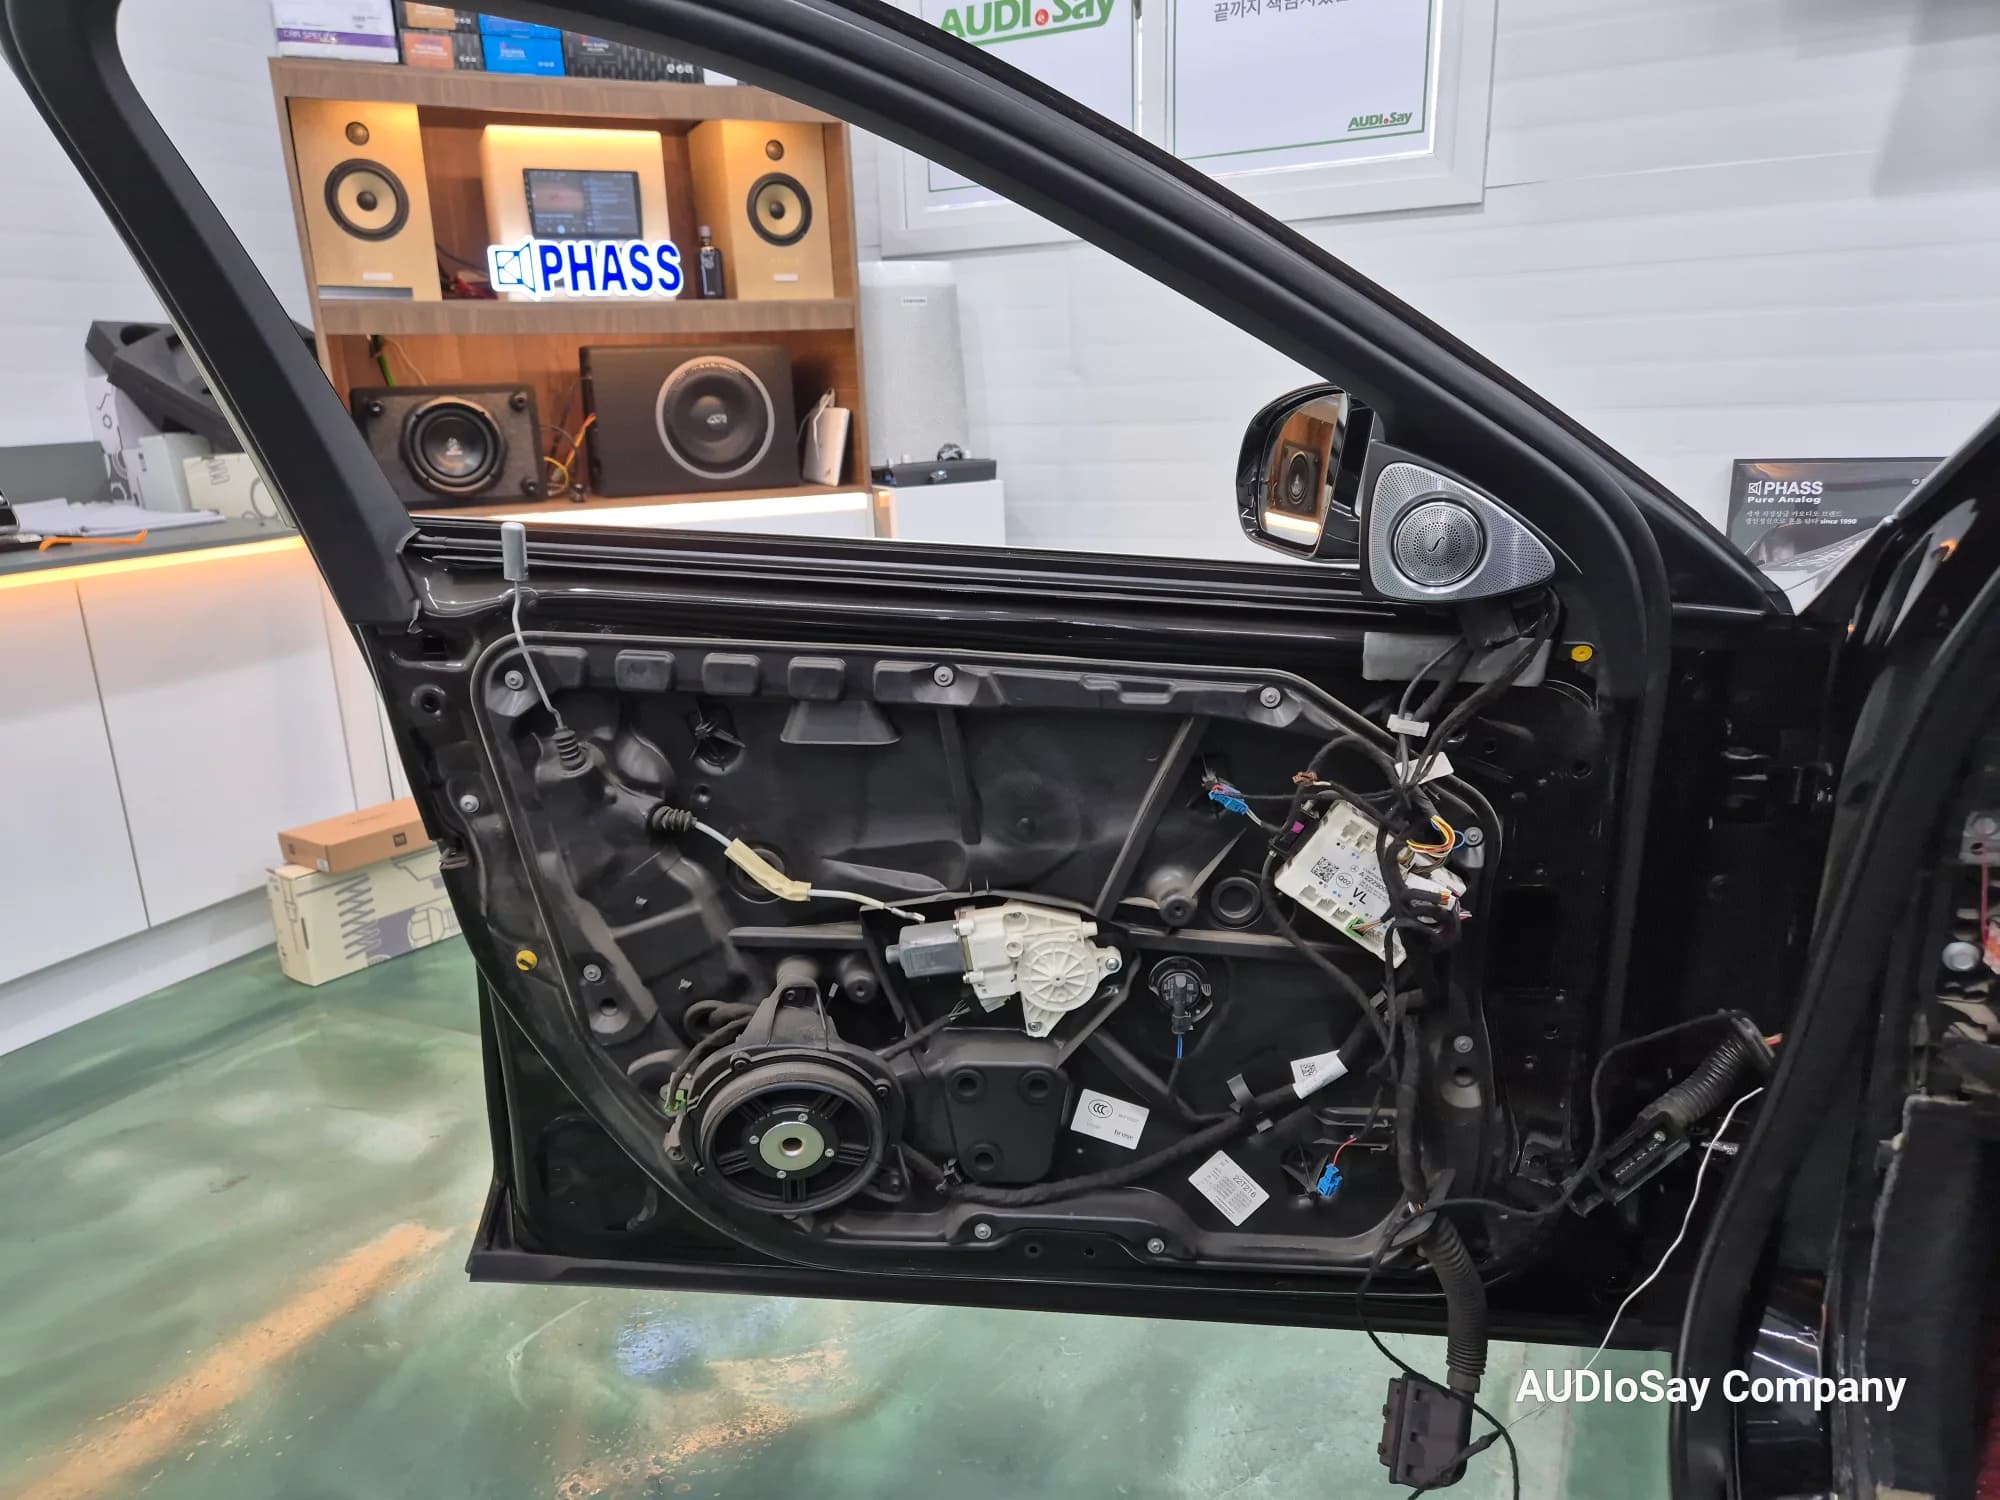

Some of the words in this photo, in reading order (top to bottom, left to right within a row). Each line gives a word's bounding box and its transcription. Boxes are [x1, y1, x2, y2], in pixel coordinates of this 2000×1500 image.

[539, 244, 681, 291] PHASS
[1763, 481, 1824, 495] PHASS
[1747, 496, 1775, 504] Pure
[1778, 495, 1822, 505] Analog
[1352, 887, 1367, 905] VL
